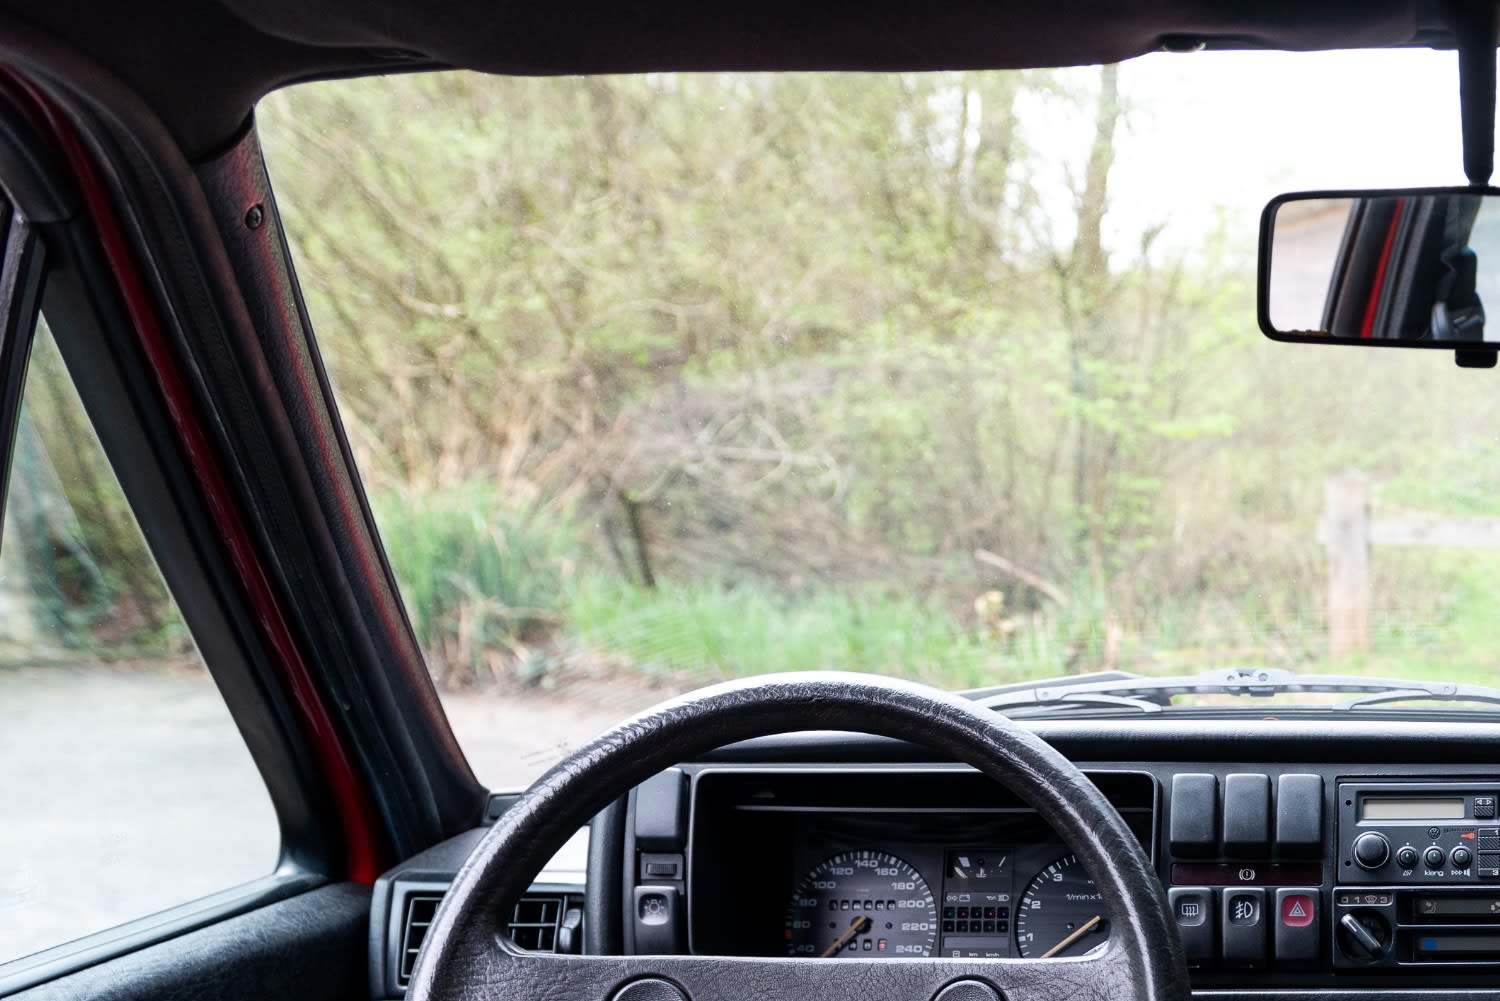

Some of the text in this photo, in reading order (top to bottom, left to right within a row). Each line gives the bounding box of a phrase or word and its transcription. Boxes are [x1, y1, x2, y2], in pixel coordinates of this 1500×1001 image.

[854, 859, 879, 868] 140
[829, 867, 854, 876] 120
[874, 868, 899, 876] 160
[1053, 873, 1063, 882] 3
[812, 881, 837, 889] 100
[891, 882, 915, 890] 180
[898, 900, 925, 908] 200
[1354, 896, 1360, 904] 1
[1380, 896, 1388, 904] 3
[1031, 900, 1041, 909] 2
[902, 923, 928, 931] 220
[1026, 933, 1034, 942] 1
[896, 945, 923, 953] 240
